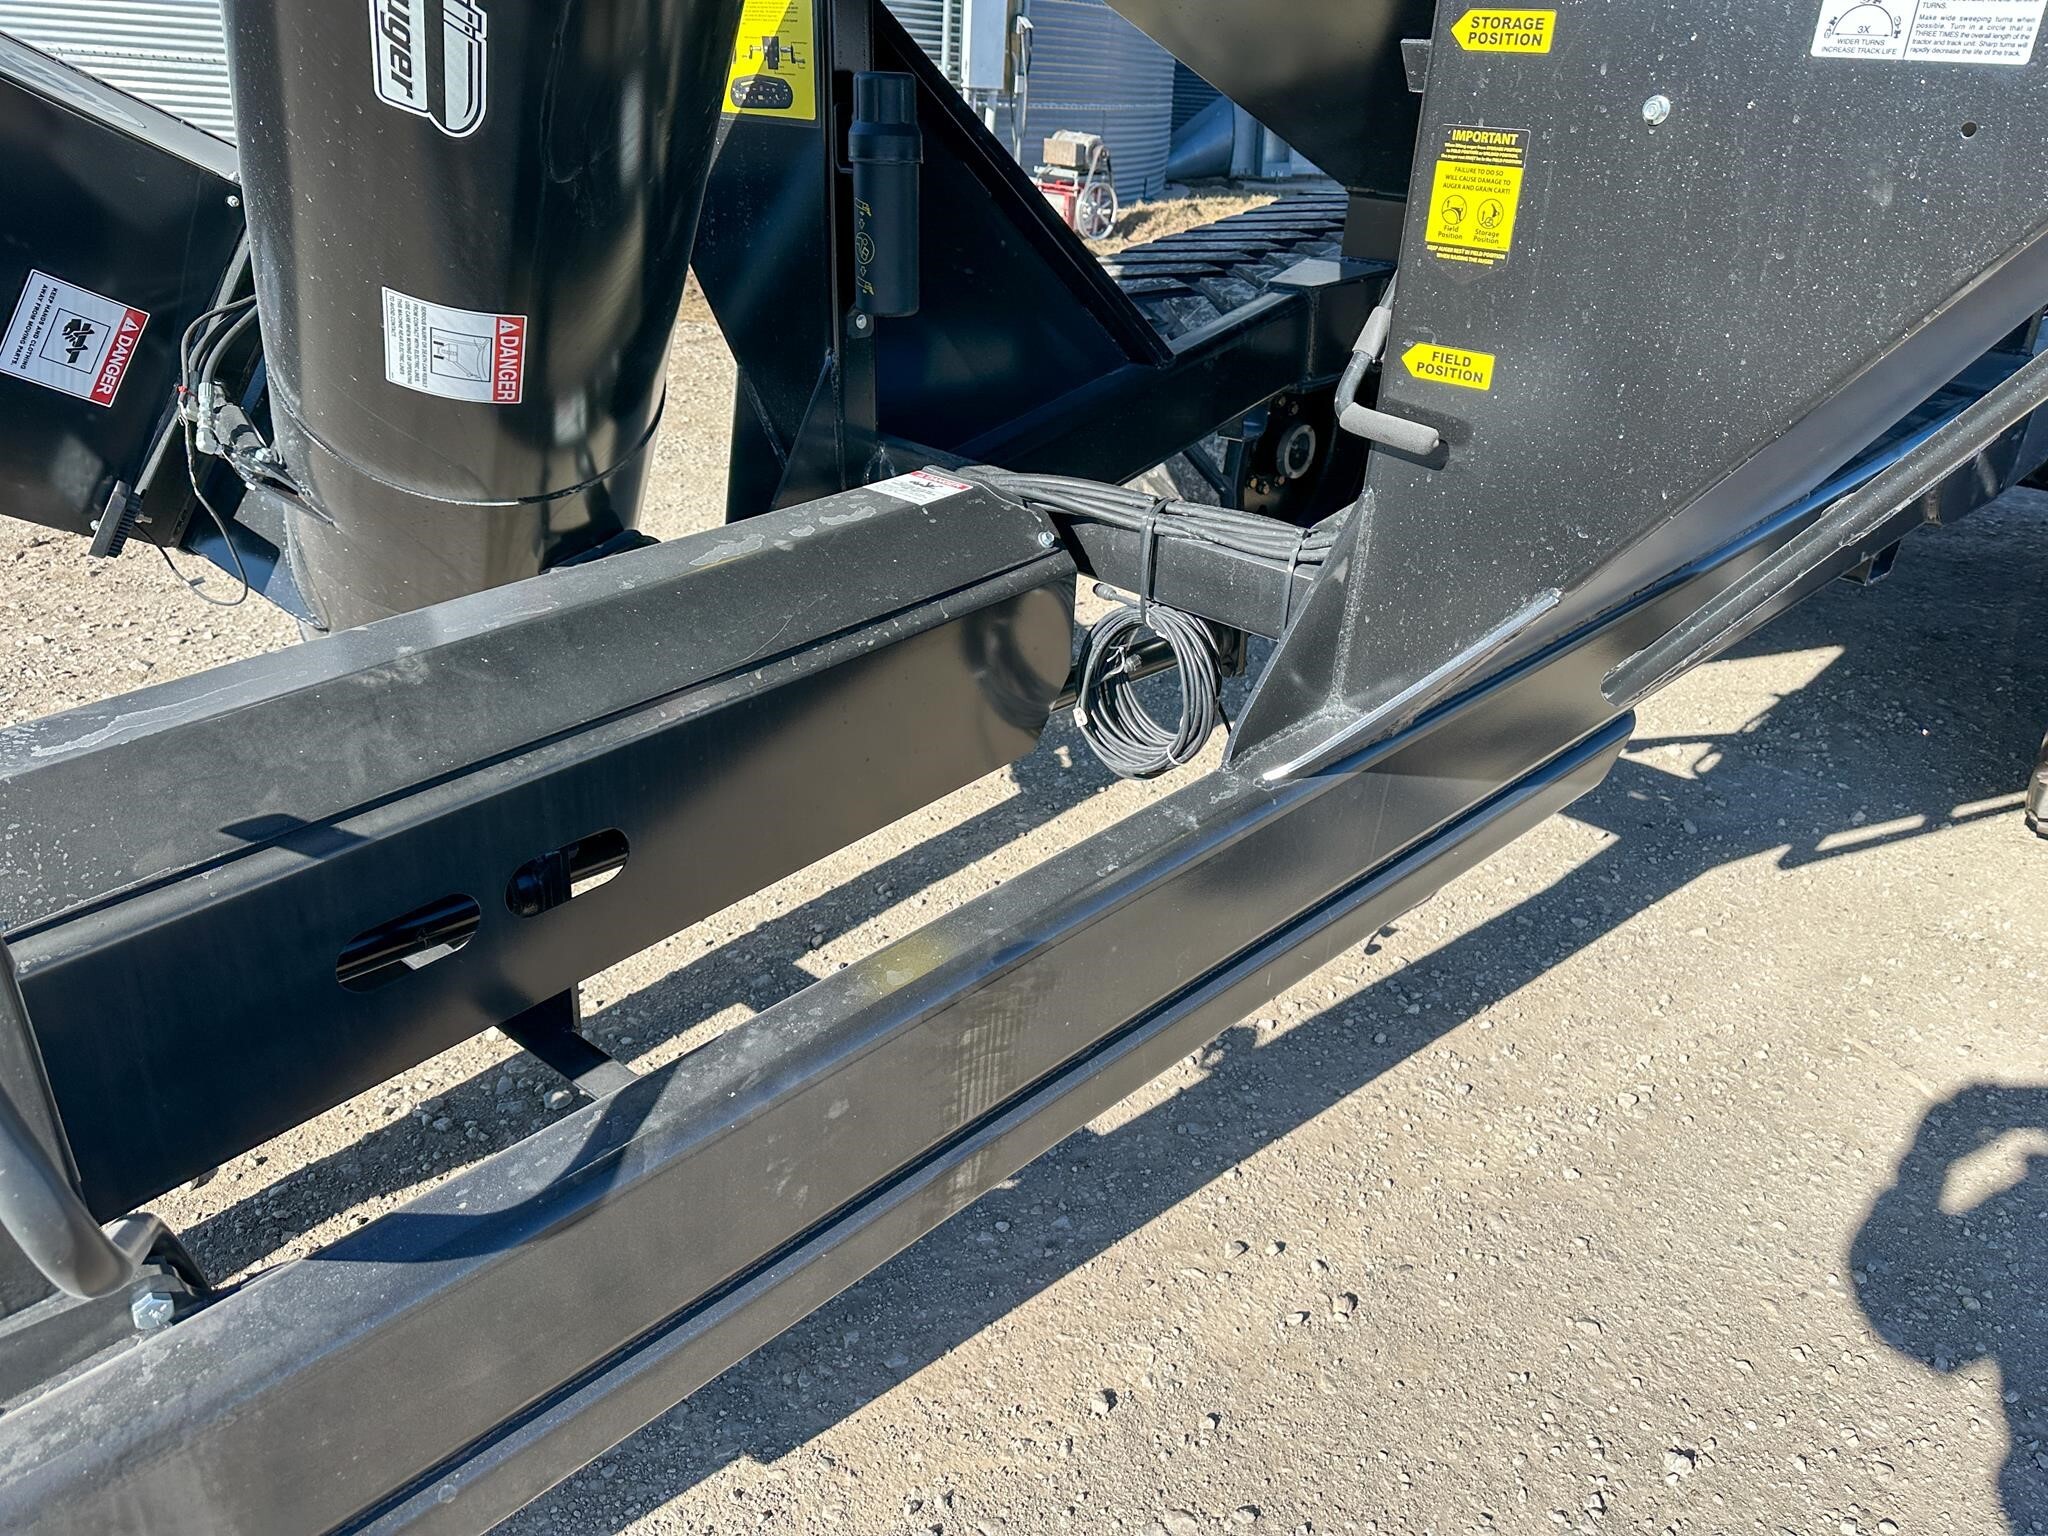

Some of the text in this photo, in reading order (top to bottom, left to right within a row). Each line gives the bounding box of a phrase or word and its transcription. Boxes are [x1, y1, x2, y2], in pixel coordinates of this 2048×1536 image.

[1471, 16, 1545, 30] STORAGE
[1857, 25, 1871, 34] 3X
[1468, 32, 1543, 46] POSITION
[1452, 129, 1519, 145] IMPORTANT
[1454, 166, 1476, 174] FAILURE
[1459, 175, 1476, 183] CAUSE
[1477, 177, 1501, 185] DAMAGE
[1438, 231, 1463, 240] Position
[1473, 235, 1499, 244] Position
[1475, 229, 1499, 238] Storage
[10, 284, 48, 366] AWAY FROM MOVING PARTS.
[20, 287, 58, 369] KEEP HANDS AND CLOTHING
[96, 334, 133, 395] DANGER
[1432, 351, 1471, 367] FIELD
[497, 336, 519, 400] DANGER
[1417, 362, 1483, 383] POSITION
